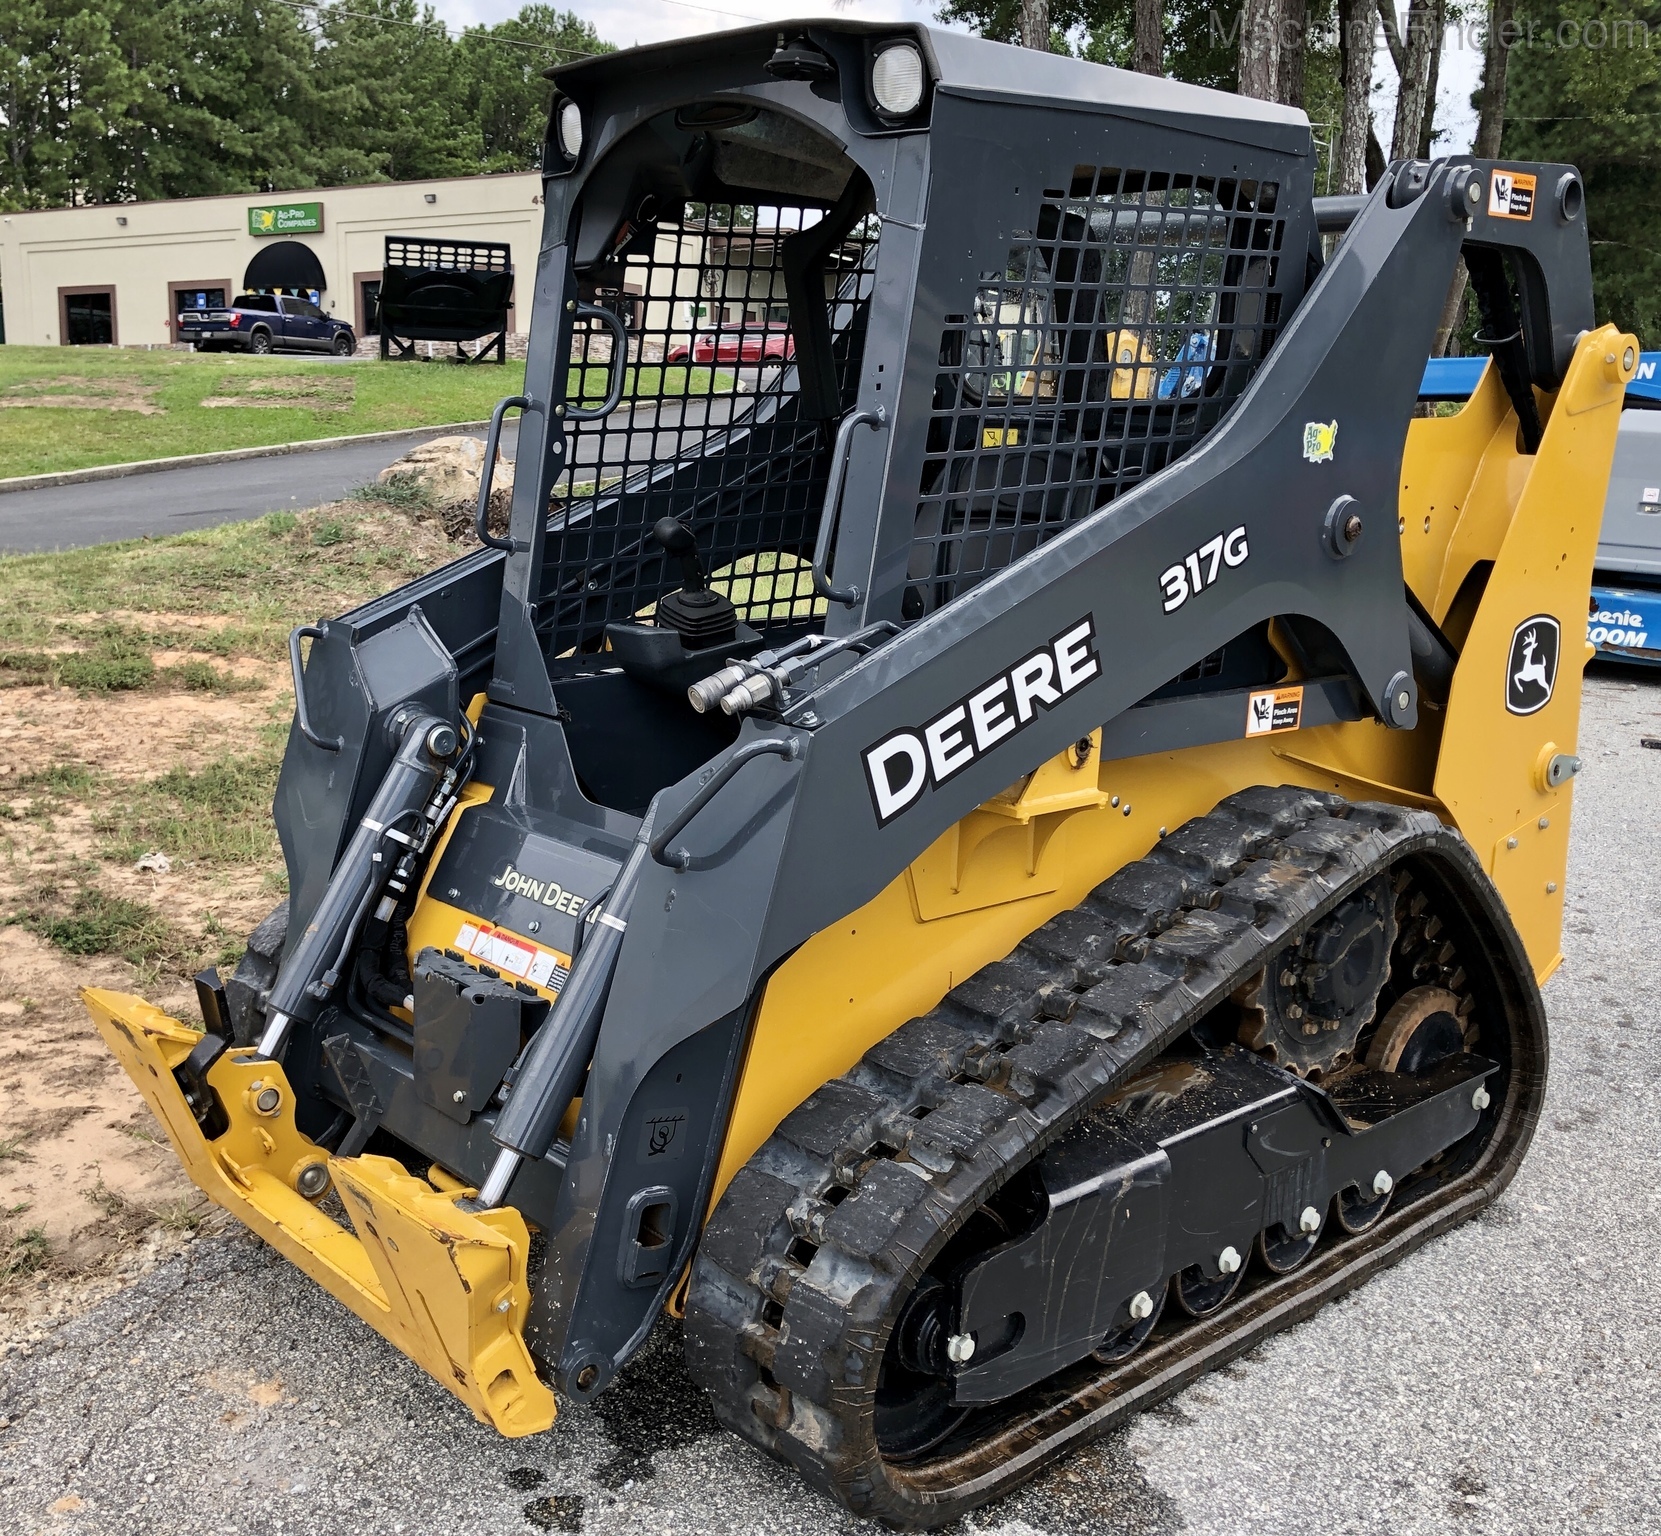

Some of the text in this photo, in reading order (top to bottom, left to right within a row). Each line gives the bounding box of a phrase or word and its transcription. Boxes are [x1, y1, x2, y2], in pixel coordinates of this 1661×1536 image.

[1306, 440, 1321, 454] Pro
[1158, 524, 1249, 615] 317G
[861, 613, 1101, 829] DEERE
[493, 864, 546, 903] JOHN
